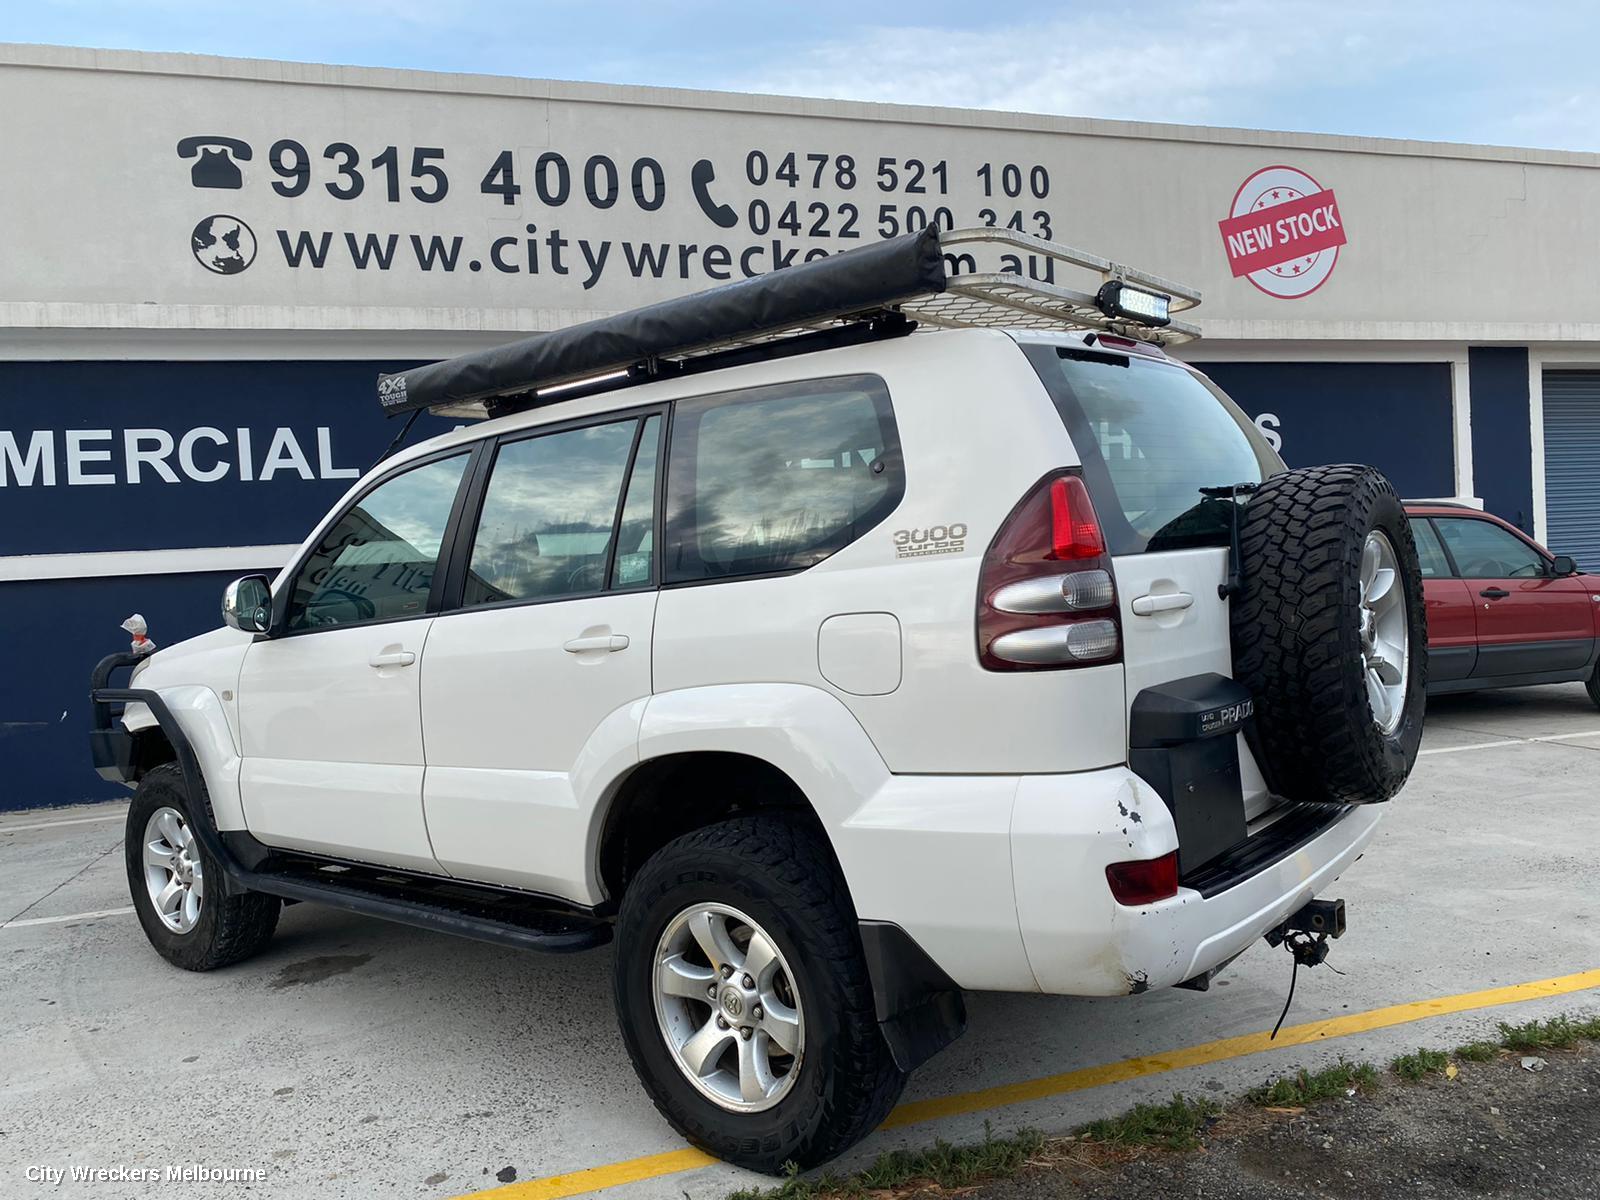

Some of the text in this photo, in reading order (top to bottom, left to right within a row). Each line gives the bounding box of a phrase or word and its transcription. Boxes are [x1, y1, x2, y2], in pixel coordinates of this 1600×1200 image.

[269, 139, 666, 212] 9315 4000
[745, 150, 1051, 200] 0478 521 100
[747, 198, 1053, 242] 0422 500 343
[1227, 203, 1340, 259] NEW STOCK
[0, 426, 361, 488] MERCIAL
[1221, 700, 1254, 726] PRADO
